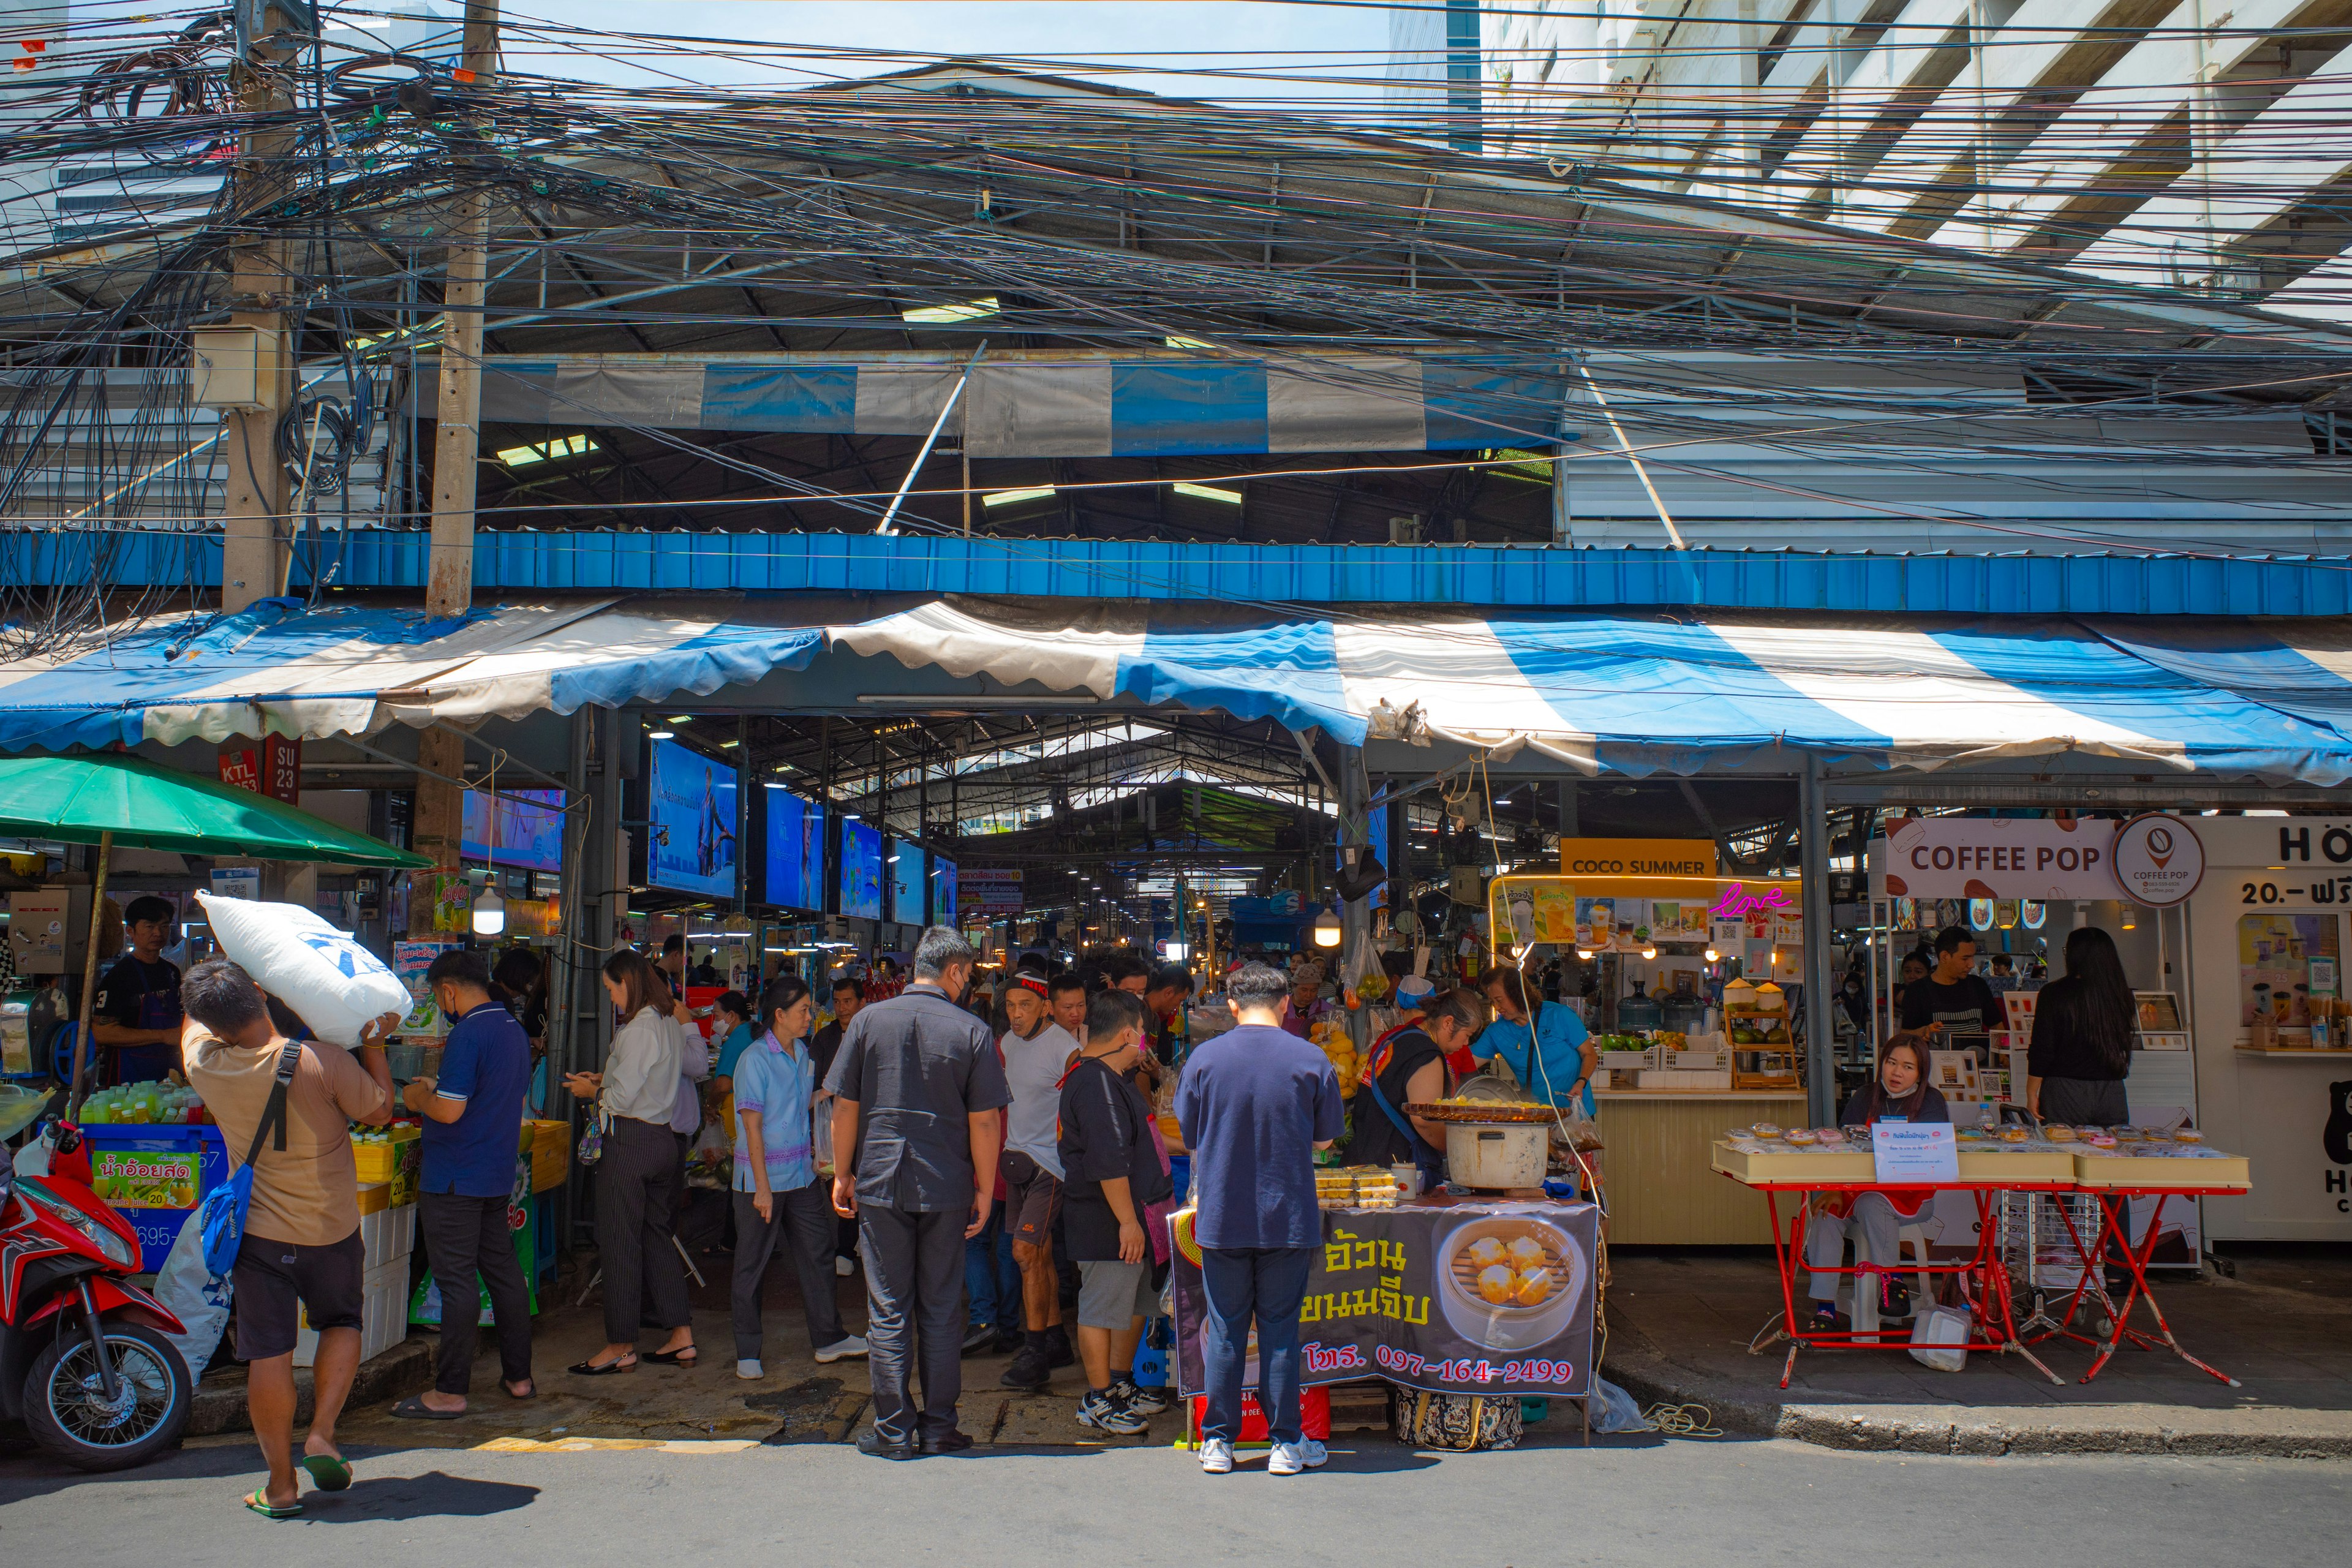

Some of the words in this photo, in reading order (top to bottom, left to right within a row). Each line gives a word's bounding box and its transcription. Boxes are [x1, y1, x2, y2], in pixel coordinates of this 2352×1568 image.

[277, 747, 294, 767] SU
[222, 764, 255, 782] KTL
[277, 769, 294, 789] 23
[233, 779, 257, 792] 53
[1572, 860, 1623, 873] COCO
[1630, 860, 1705, 875] SUMMER
[1910, 845, 2026, 871] COFFEE
[2037, 846, 2100, 872] POP
[959, 871, 993, 880] ตลาดสีลม
[1708, 883, 1793, 917] love
[2242, 882, 2304, 904] 20.-
[96, 990, 107, 1008] 3
[100, 1155, 190, 1178] น้ำอ้อยสด
[2325, 1169, 2352, 1194] H
[130, 1197, 149, 1207] juice
[135, 1226, 178, 1246] 695-
[1325, 1228, 1408, 1273] อ้วน
[1298, 1276, 1431, 1325] ขนมจีบ
[1303, 1341, 1366, 1373] โทร.
[1376, 1343, 1574, 1385] 097-164-2499
[1248, 1408, 1261, 1417] DEE
